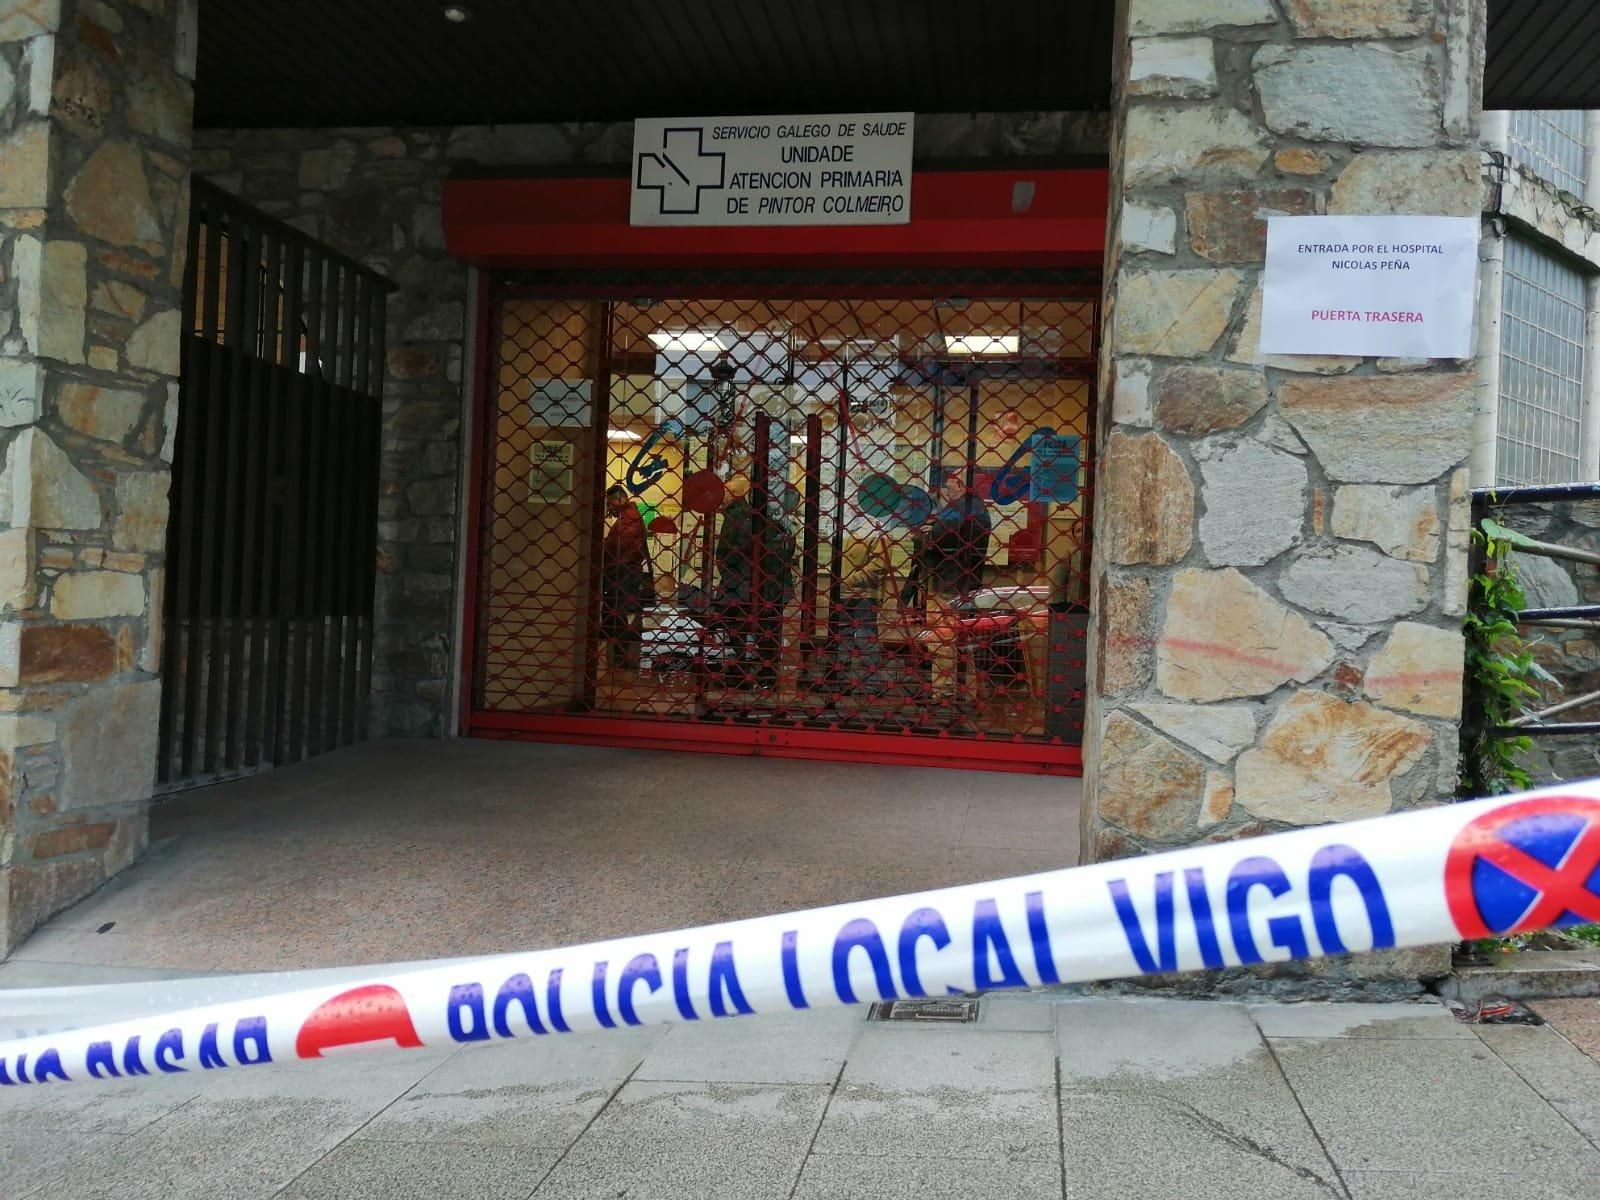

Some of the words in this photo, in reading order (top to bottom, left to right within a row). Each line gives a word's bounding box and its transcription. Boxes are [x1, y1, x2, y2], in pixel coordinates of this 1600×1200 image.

[712, 125, 771, 141] SERVICIO
[776, 124, 831, 139] GALEGO
[837, 123, 856, 137] DE
[861, 122, 907, 137] SAUDE
[781, 145, 854, 163] UNIDADE
[728, 172, 811, 190] ATENCION
[820, 170, 904, 188] PRIMARIA
[726, 197, 749, 215] DE
[758, 196, 816, 214] PINTOR
[822, 195, 904, 214] COLMEIRO
[1297, 243, 1350, 254] ENTRADA
[1351, 243, 1374, 254] POR
[1376, 244, 1389, 254] EL
[1391, 244, 1444, 254] HOSPITAL
[1331, 260, 1378, 270] NICOLAS
[1380, 259, 1411, 270] PEÑA
[1311, 310, 1361, 321] PUERTA
[1364, 311, 1424, 323] TRASERA
[1105, 843, 1396, 974] VIGO
